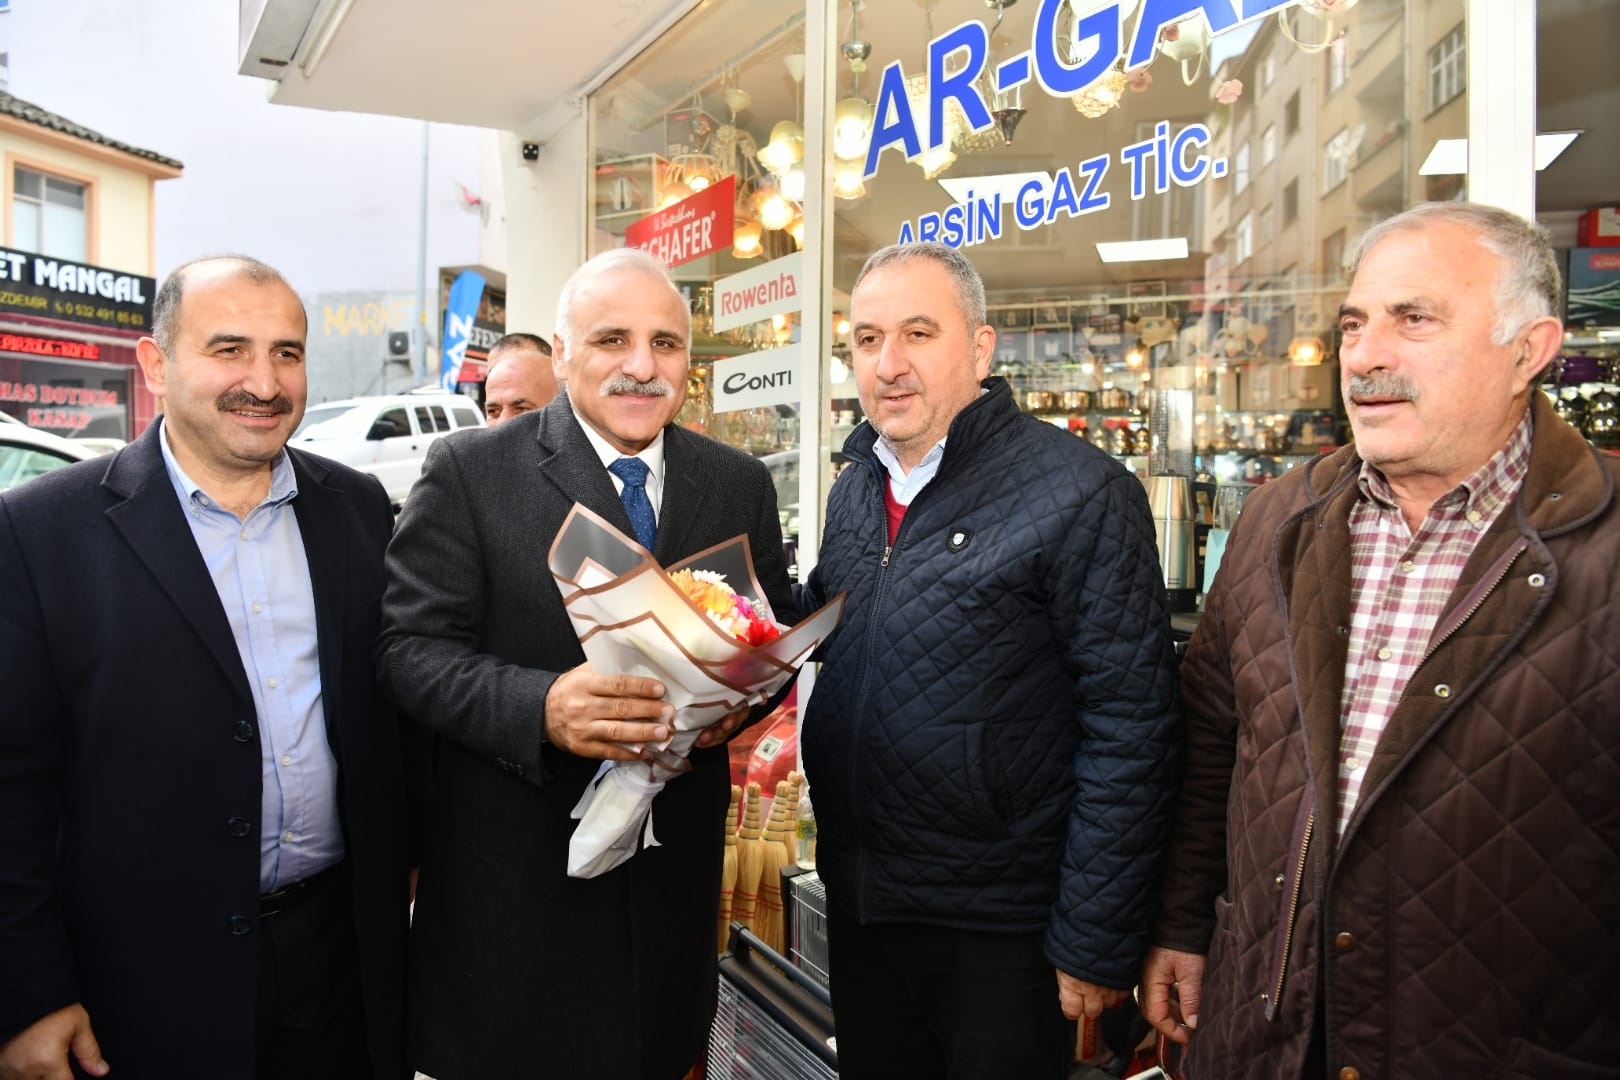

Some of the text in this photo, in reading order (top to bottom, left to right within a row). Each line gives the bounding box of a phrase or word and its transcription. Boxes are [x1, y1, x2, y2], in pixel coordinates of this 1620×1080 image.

[862, 0, 1298, 179] AR-G
[1014, 153, 1111, 231] GAZ
[1121, 120, 1228, 200] TİC.
[34, 258, 146, 304] MANGAL
[721, 272, 797, 317] Rowenta
[722, 370, 793, 395] CONTI
